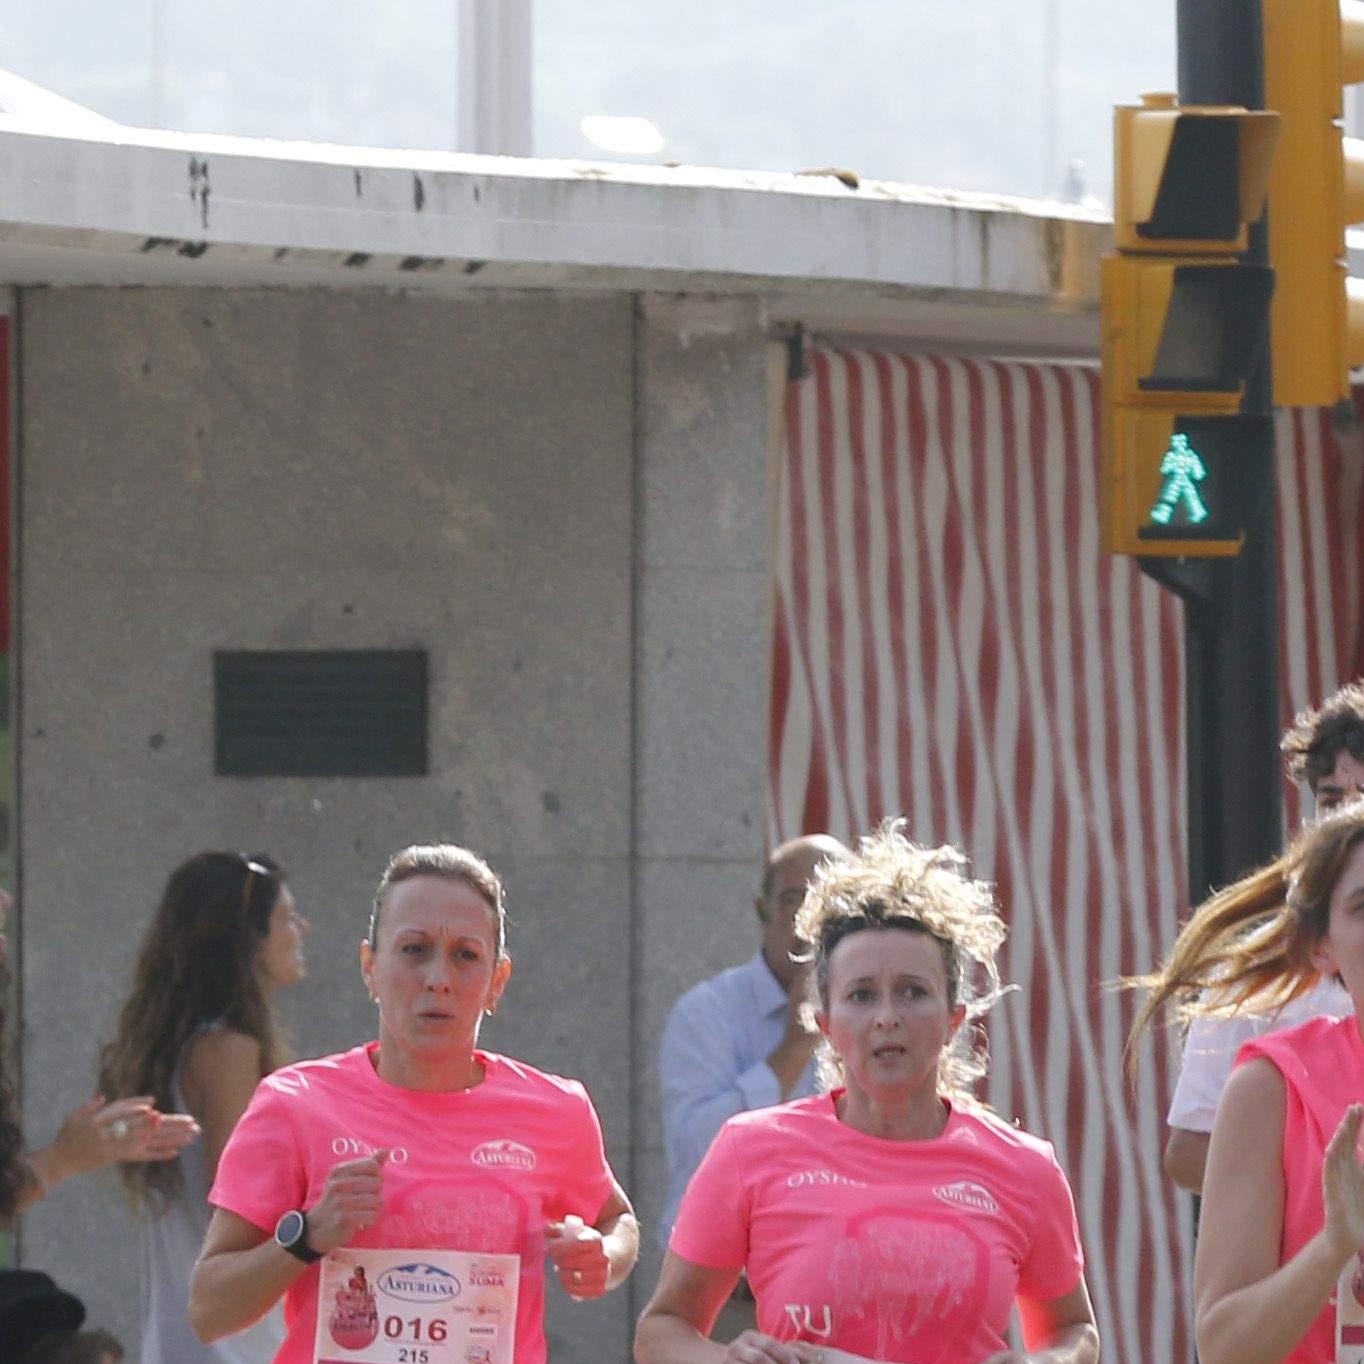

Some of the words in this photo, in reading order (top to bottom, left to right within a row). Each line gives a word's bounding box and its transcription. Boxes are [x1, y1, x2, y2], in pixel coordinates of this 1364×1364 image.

[384, 1272, 455, 1295] ASTURIANA
[384, 1316, 447, 1341] 016
[785, 1303, 832, 1338] TU
[398, 1349, 429, 1364] 215
